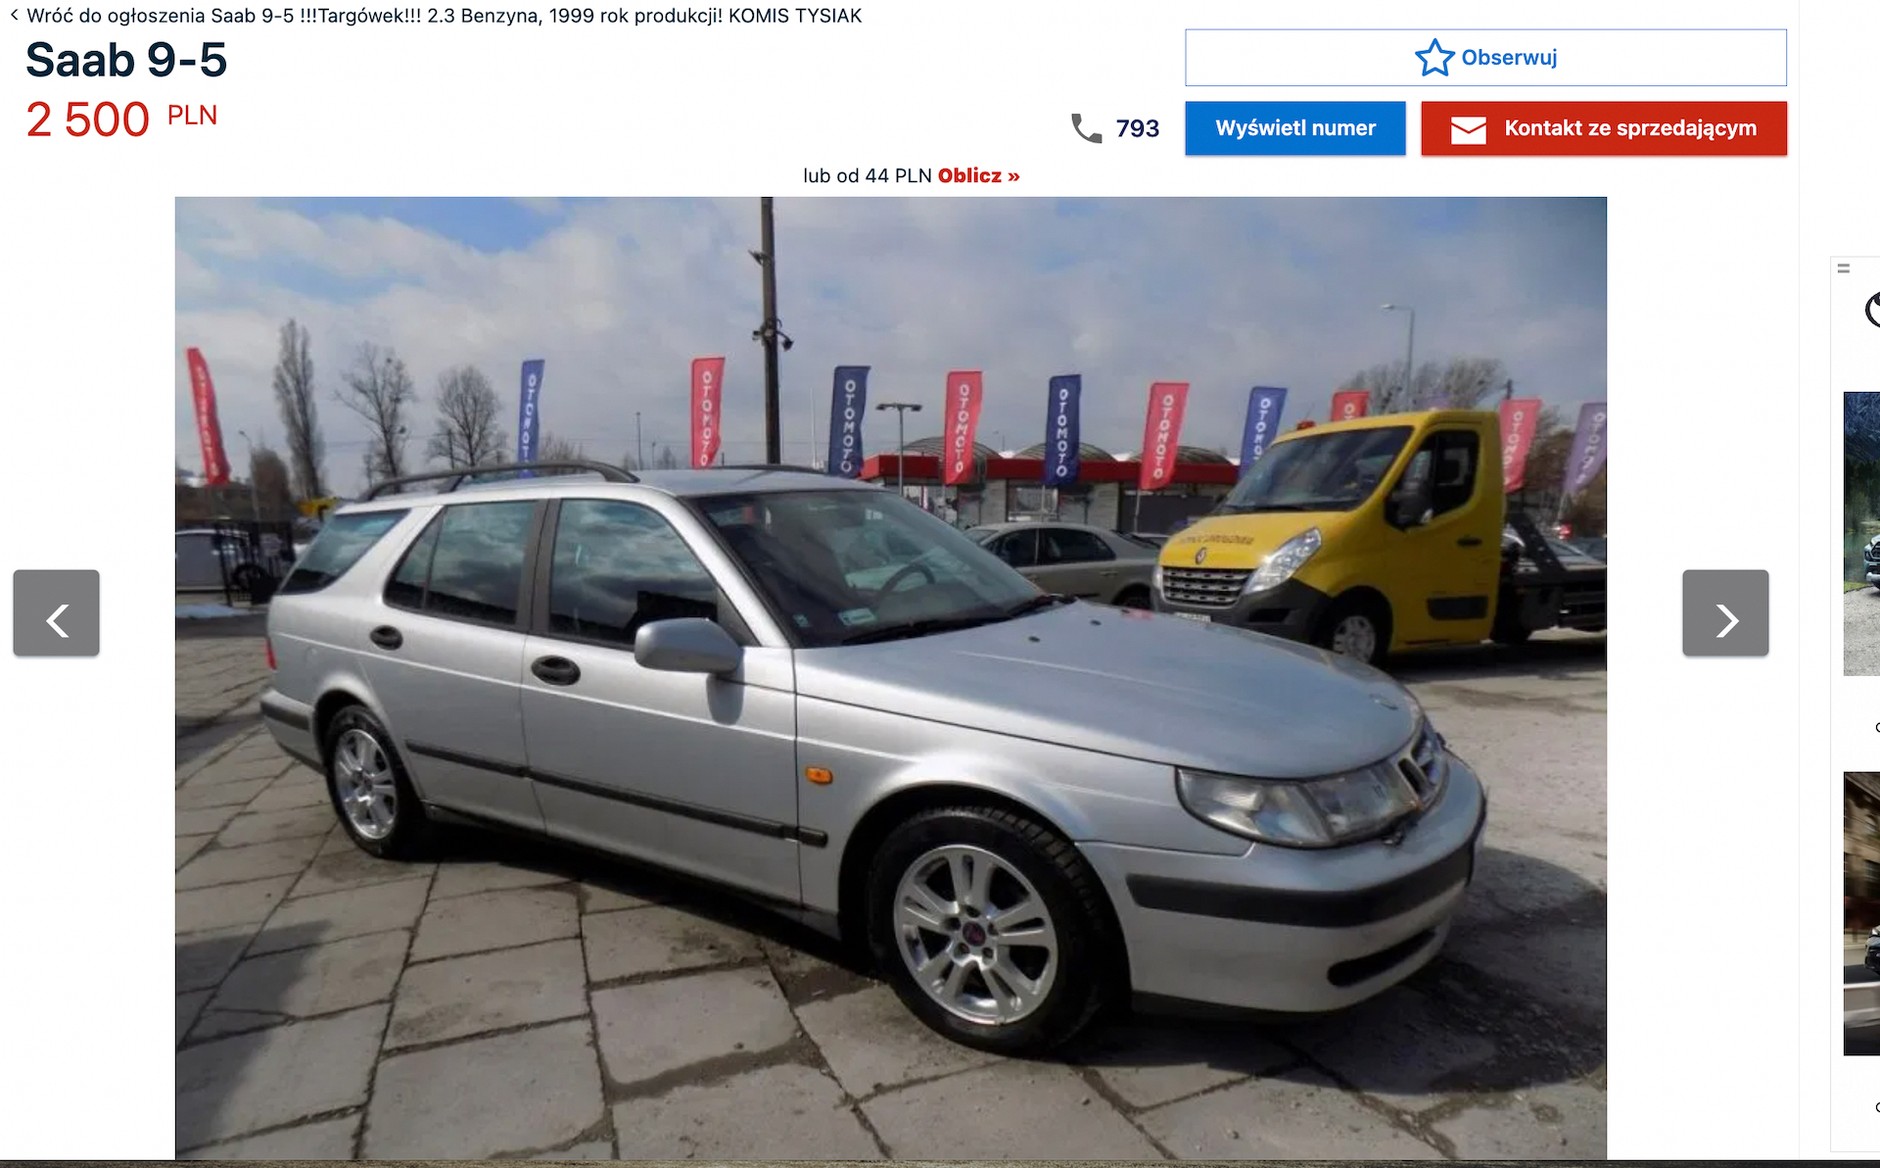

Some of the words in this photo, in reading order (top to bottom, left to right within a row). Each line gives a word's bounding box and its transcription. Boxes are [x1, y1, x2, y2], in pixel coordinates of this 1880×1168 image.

[26, 6, 74, 24] Wróć
[80, 7, 101, 24] do
[107, 6, 205, 27] ogłoszenia
[211, 7, 256, 24] Saab
[261, 7, 294, 24] 9-5
[300, 6, 422, 27] !!!Targówek!!!
[428, 7, 455, 24] 2.3
[461, 7, 543, 27] Benzyna,
[549, 7, 595, 24] 1999
[600, 7, 629, 24] rok
[634, 6, 723, 27] produkcji!
[729, 7, 790, 24] KOMIS
[794, 7, 863, 24] TYSIAK
[25, 40, 134, 78] Saab
[147, 40, 228, 78] 9-5
[1461, 47, 1558, 70] Obserwuj
[27, 100, 52, 137] 2
[65, 100, 150, 138] 500
[168, 103, 217, 126] PLN
[1116, 118, 1160, 139] 793
[1215, 117, 1307, 141] Wyświetl
[1311, 122, 1378, 137] numer
[1505, 118, 1583, 137] Kontakt
[1588, 122, 1612, 137] ze
[1616, 118, 1758, 142] sprzedającym
[804, 167, 831, 184] lub
[836, 167, 859, 184] od
[864, 167, 890, 184] 44
[895, 167, 932, 184] PLN
[937, 166, 1003, 184] Oblicz
[700, 371, 712, 466] OTOMOTO
[840, 379, 856, 473] OTOMOTO
[955, 384, 970, 473] OTOMOTO
[1056, 388, 1069, 477] OTOMOTO
[1153, 394, 1174, 480] OTOMOTO
[1253, 398, 1272, 460] OTOMO
